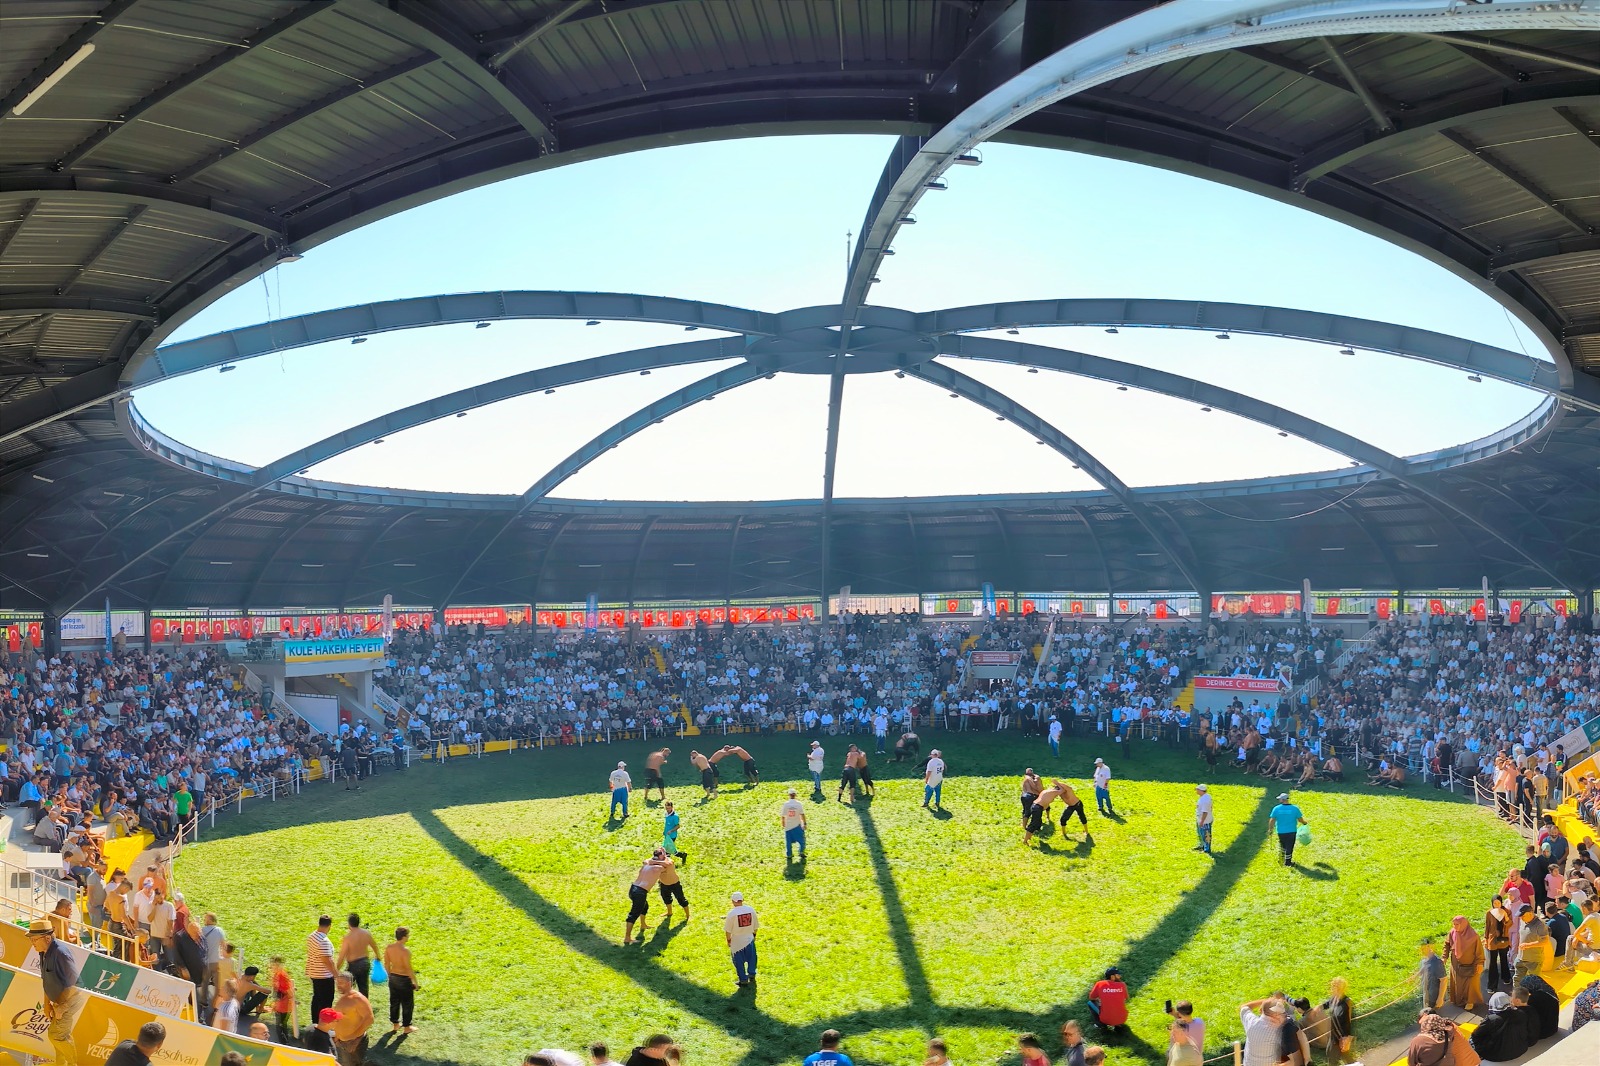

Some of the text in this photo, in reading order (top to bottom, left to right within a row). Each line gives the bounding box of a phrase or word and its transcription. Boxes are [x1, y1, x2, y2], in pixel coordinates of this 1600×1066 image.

[289, 643, 381, 656] KULE HAKEM HEYETİ
[11, 1009, 50, 1029] Cer
[86, 1043, 113, 1060] YELKE
